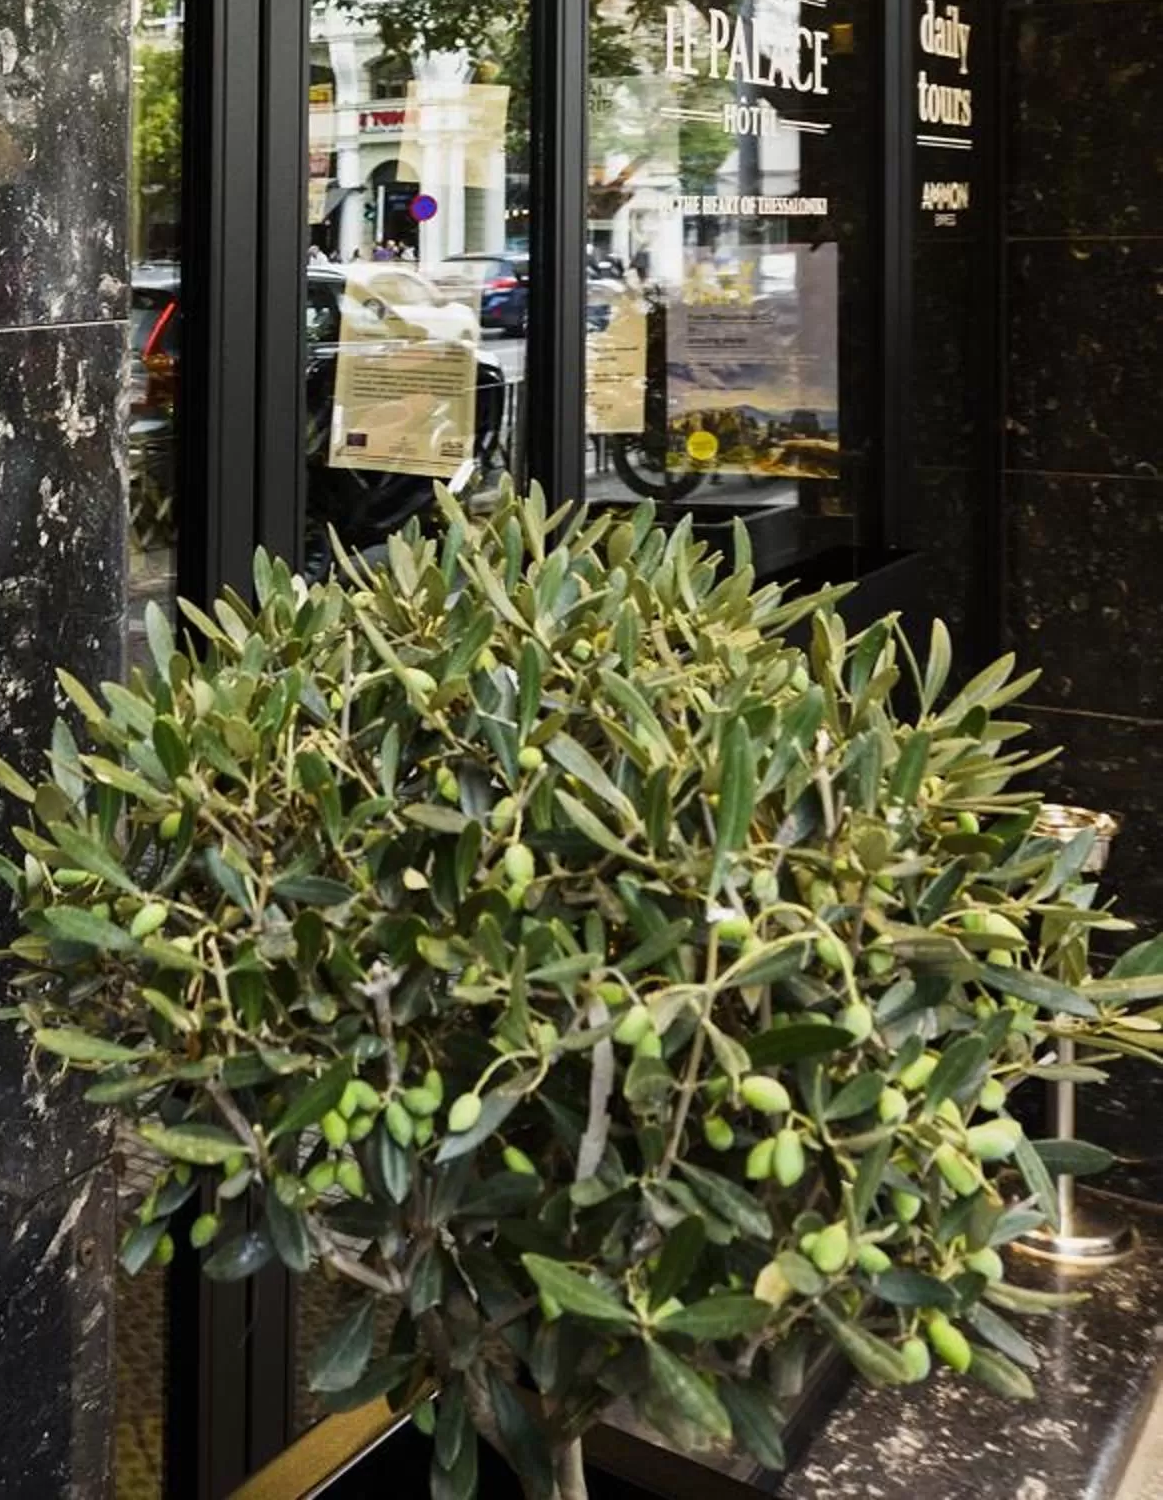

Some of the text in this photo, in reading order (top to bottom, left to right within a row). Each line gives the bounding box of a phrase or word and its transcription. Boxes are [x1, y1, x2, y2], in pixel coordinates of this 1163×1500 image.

[665, 5, 830, 95] LE PALACE
[917, 70, 972, 127] tours
[740, 195, 756, 215] OF
